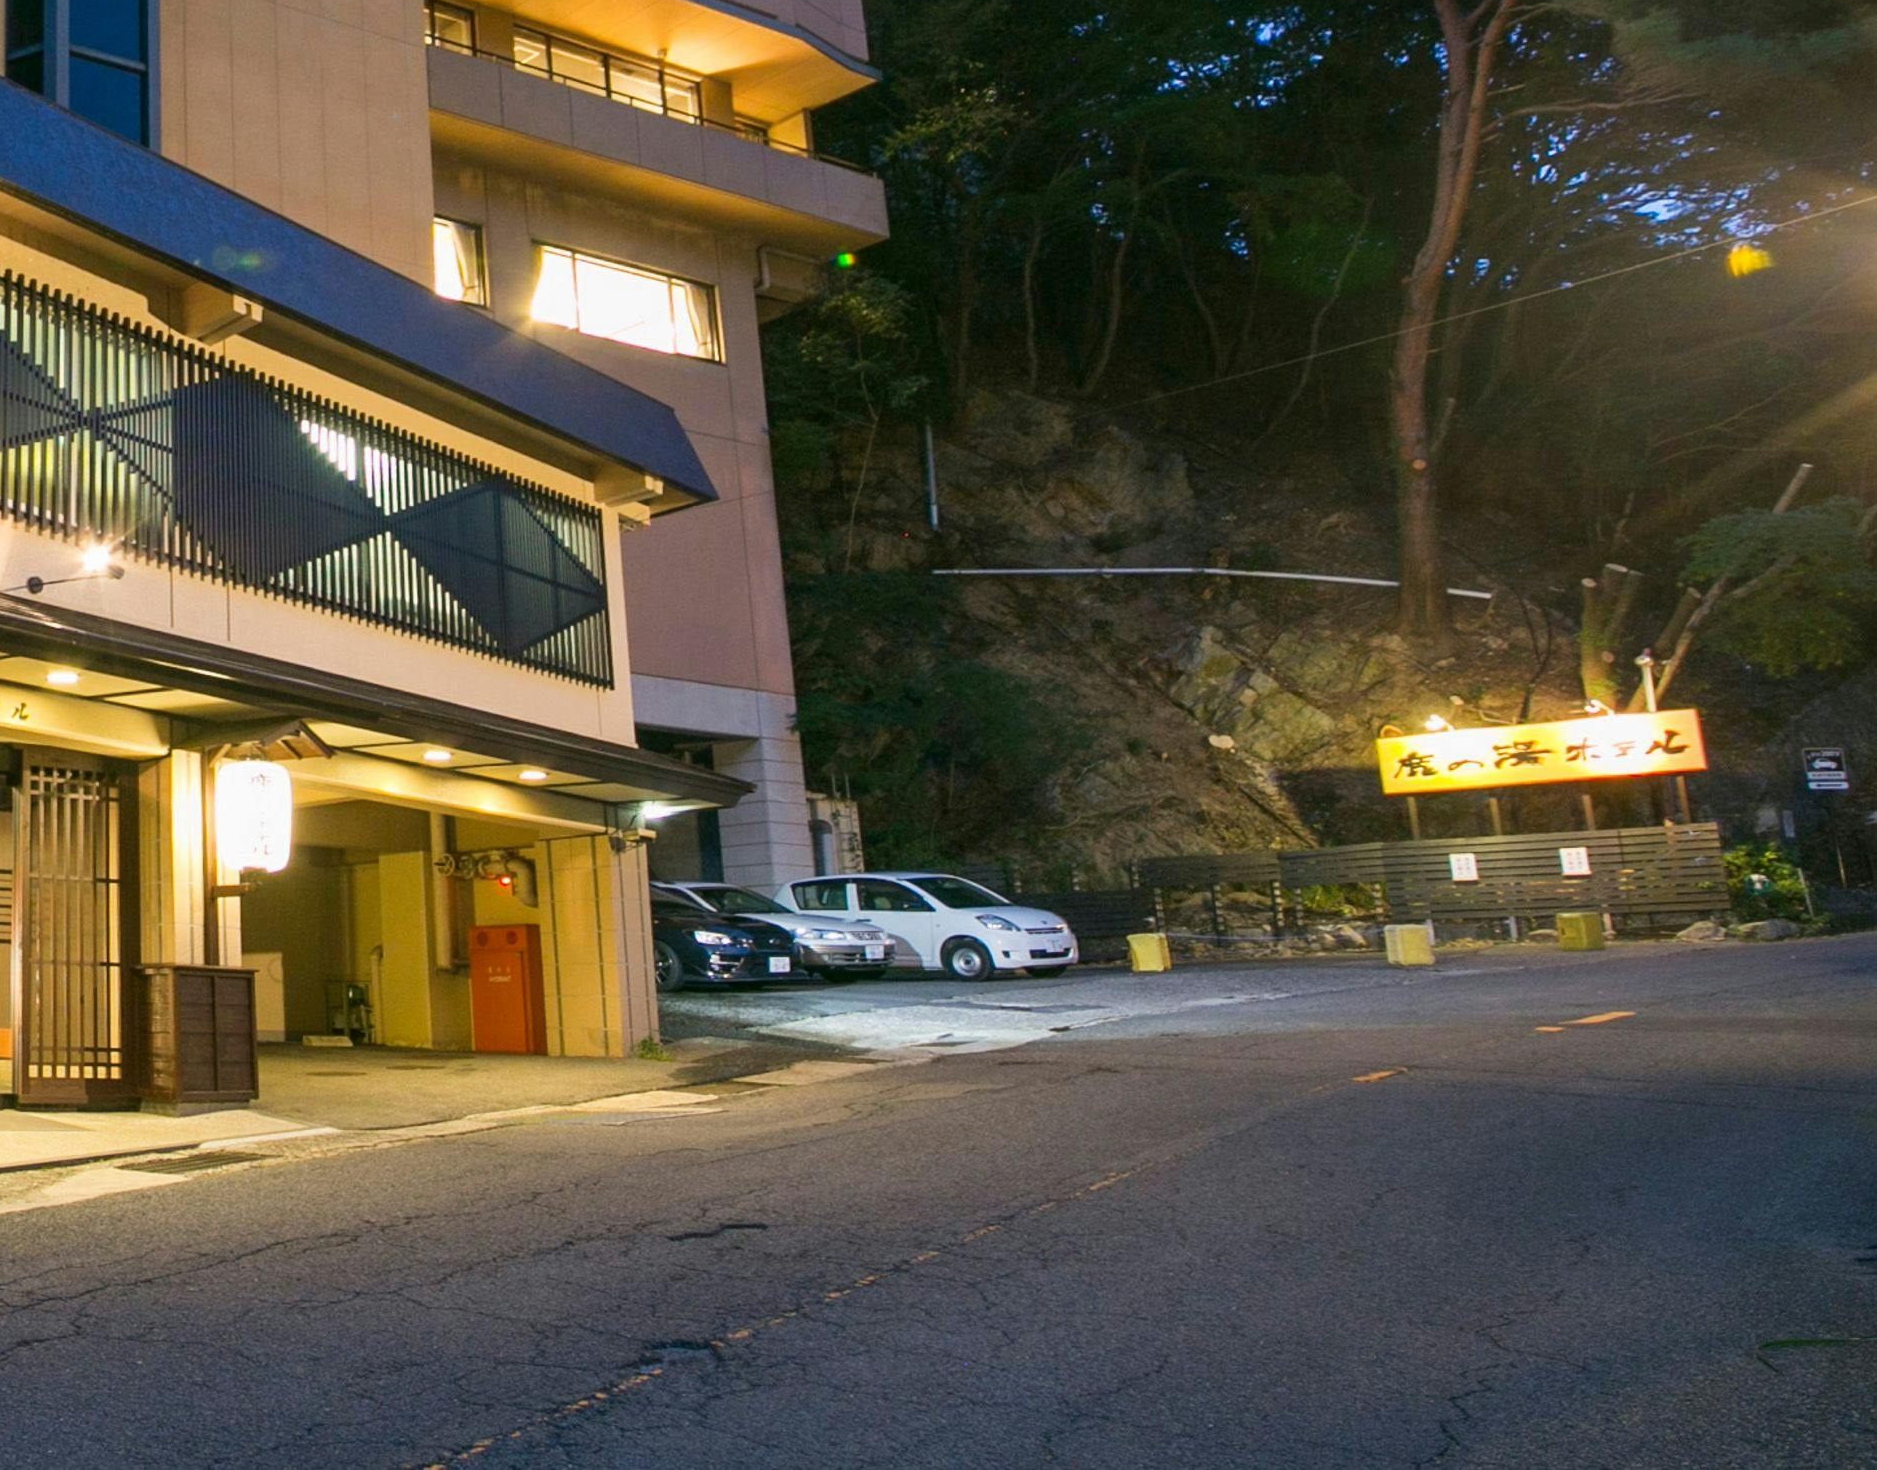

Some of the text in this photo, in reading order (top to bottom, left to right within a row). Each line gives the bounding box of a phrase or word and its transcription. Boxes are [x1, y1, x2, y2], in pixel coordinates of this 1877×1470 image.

[1395, 730, 1690, 778] 鹿の湯ホテル
